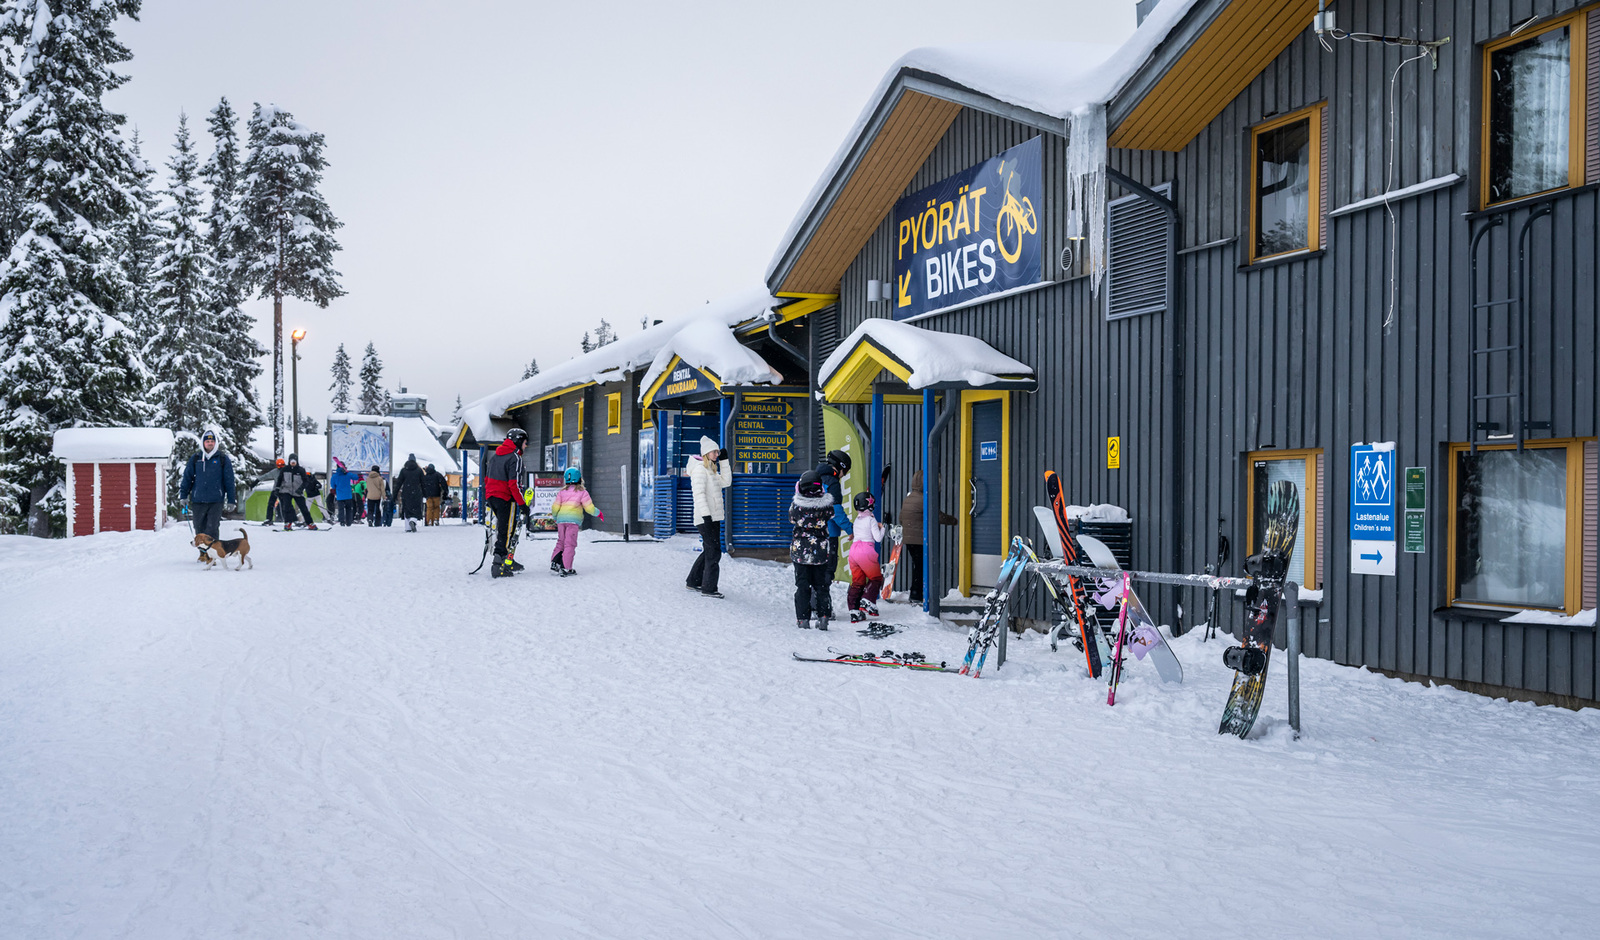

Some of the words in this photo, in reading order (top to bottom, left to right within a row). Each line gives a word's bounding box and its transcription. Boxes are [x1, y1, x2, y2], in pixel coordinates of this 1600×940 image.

[899, 185, 986, 260] PYÖRÄT
[926, 238, 996, 300] BIKES
[673, 368, 691, 382] RENTAL
[667, 379, 698, 395] VUOKRAAMO
[742, 404, 783, 413] UOKRAAMO
[738, 421, 765, 429] RENTAL
[738, 436, 786, 445] HIIHTOKOULU
[752, 452, 781, 460] SCHOOL
[1356, 513, 1389, 521] Lastenalue
